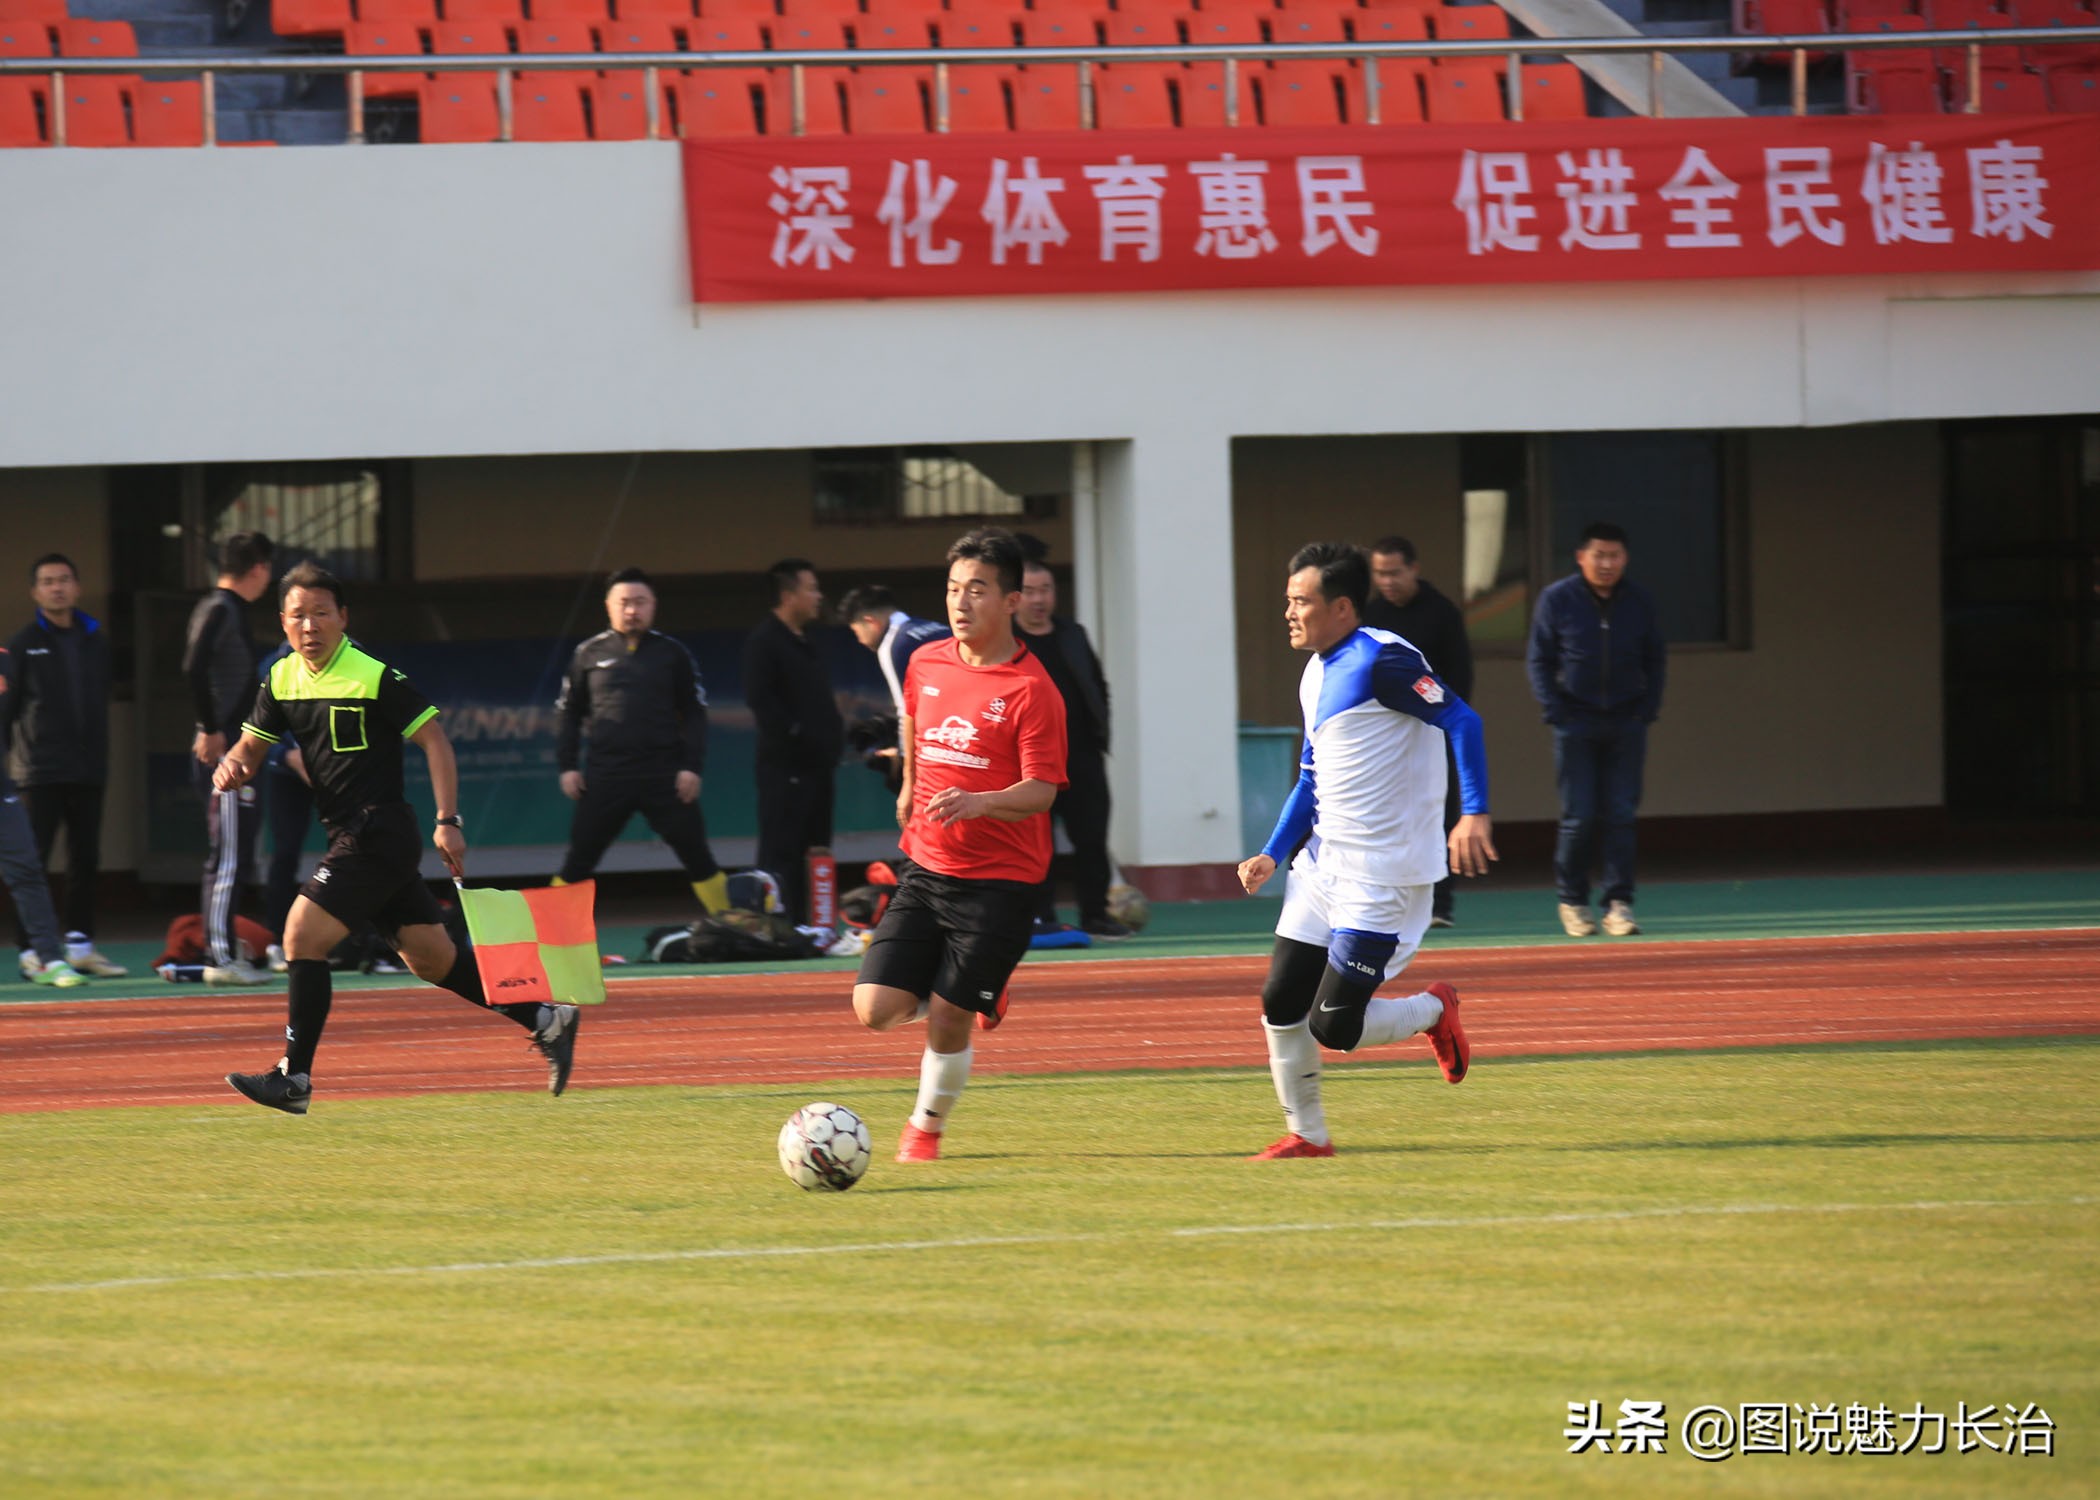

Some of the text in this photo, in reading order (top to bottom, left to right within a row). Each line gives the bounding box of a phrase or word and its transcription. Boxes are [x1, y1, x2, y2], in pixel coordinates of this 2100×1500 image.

[769, 140, 2053, 270] 深化体育惠民 促进全民健康
